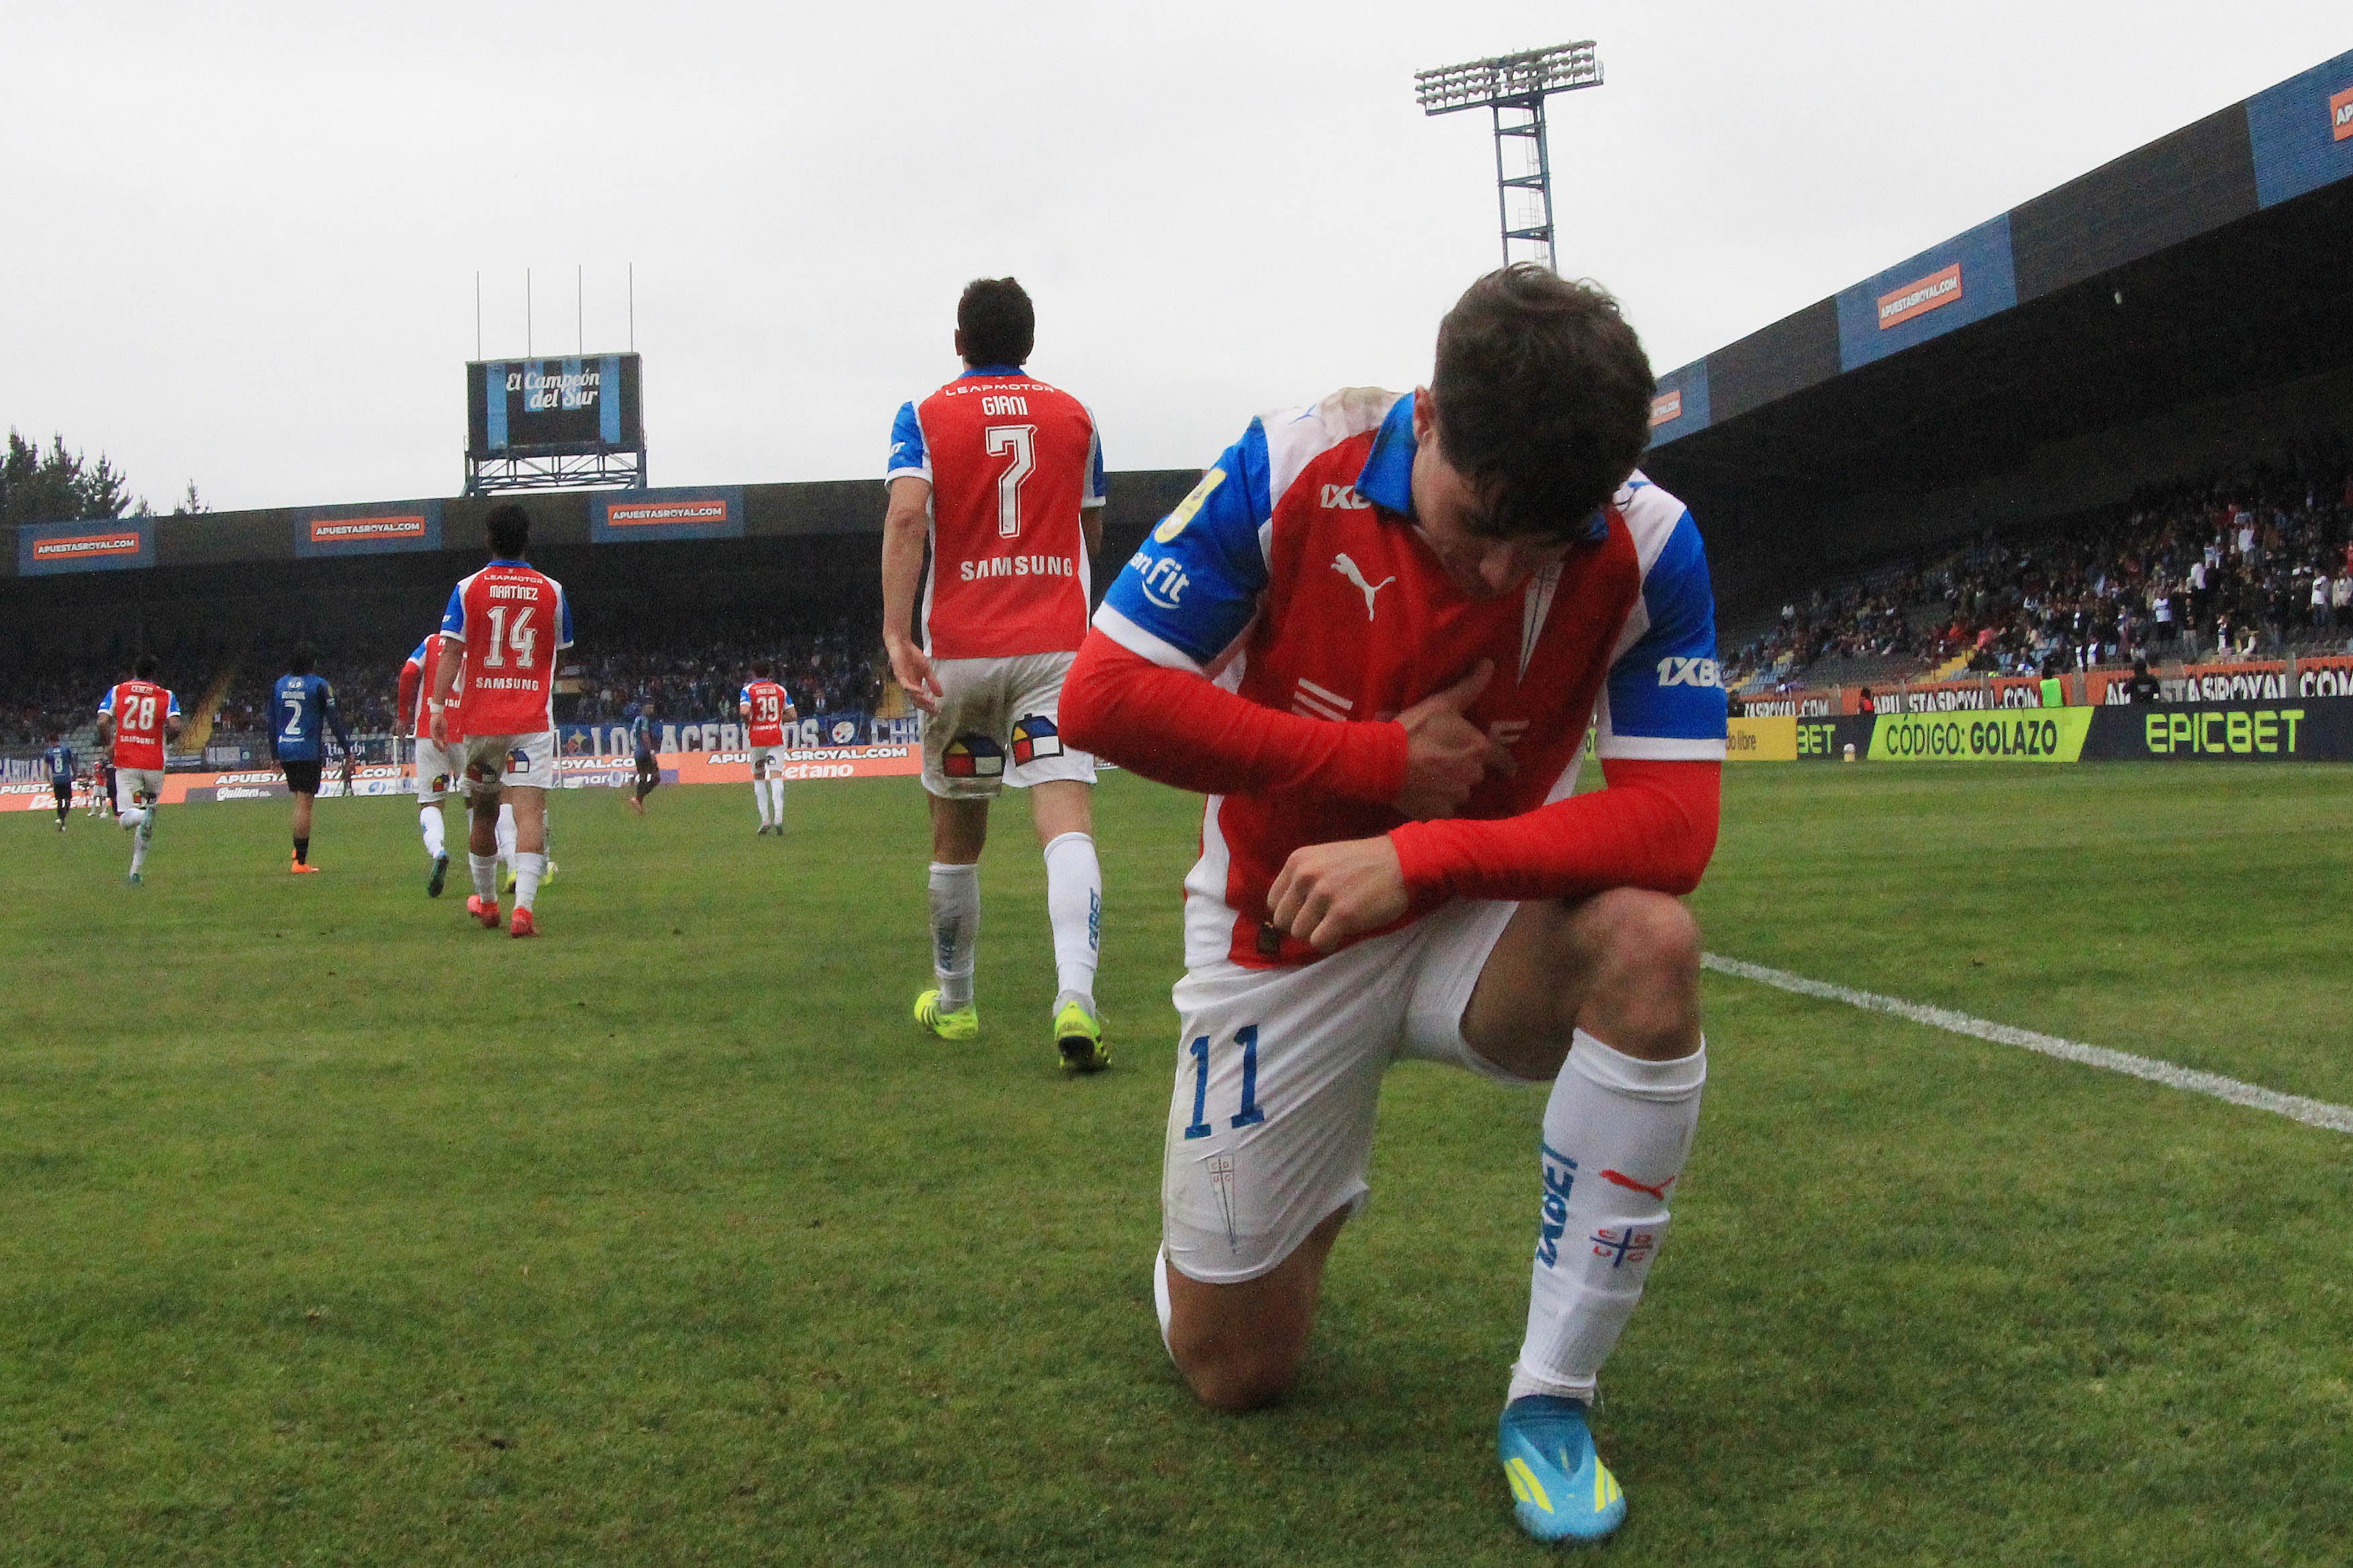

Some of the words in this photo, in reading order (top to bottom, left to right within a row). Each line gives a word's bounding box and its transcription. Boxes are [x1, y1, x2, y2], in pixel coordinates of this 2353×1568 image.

[506, 373, 522, 391] El
[524, 368, 600, 393] Campeón
[945, 383, 1055, 397] LEAPMOTOR
[529, 389, 559, 409] del
[562, 387, 598, 407] Sur
[981, 395, 1029, 416] GIANI
[985, 424, 1038, 538] 7
[612, 507, 723, 521] APUESTASROYAL.COM
[316, 522, 420, 536] APUESTASROYAL.COM
[37, 540, 136, 554] APUESTASROYAL.COM
[483, 575, 543, 585] LEAPMOTOR
[961, 555, 1073, 581] SAMSUNG
[1145, 557, 1190, 603] fit
[484, 605, 537, 670] 14
[475, 676, 540, 691] SAMSUNG
[1657, 656, 1725, 689] 1XB
[122, 695, 156, 730] 28
[284, 700, 302, 735] 2
[756, 696, 778, 722] 39
[1886, 714, 1966, 756] CÓDIGO:
[1970, 720, 2057, 755] GOLAZO
[2146, 709, 2305, 753] EPICBET
[781, 763, 854, 779] etano
[1184, 1024, 1264, 1140] 11
